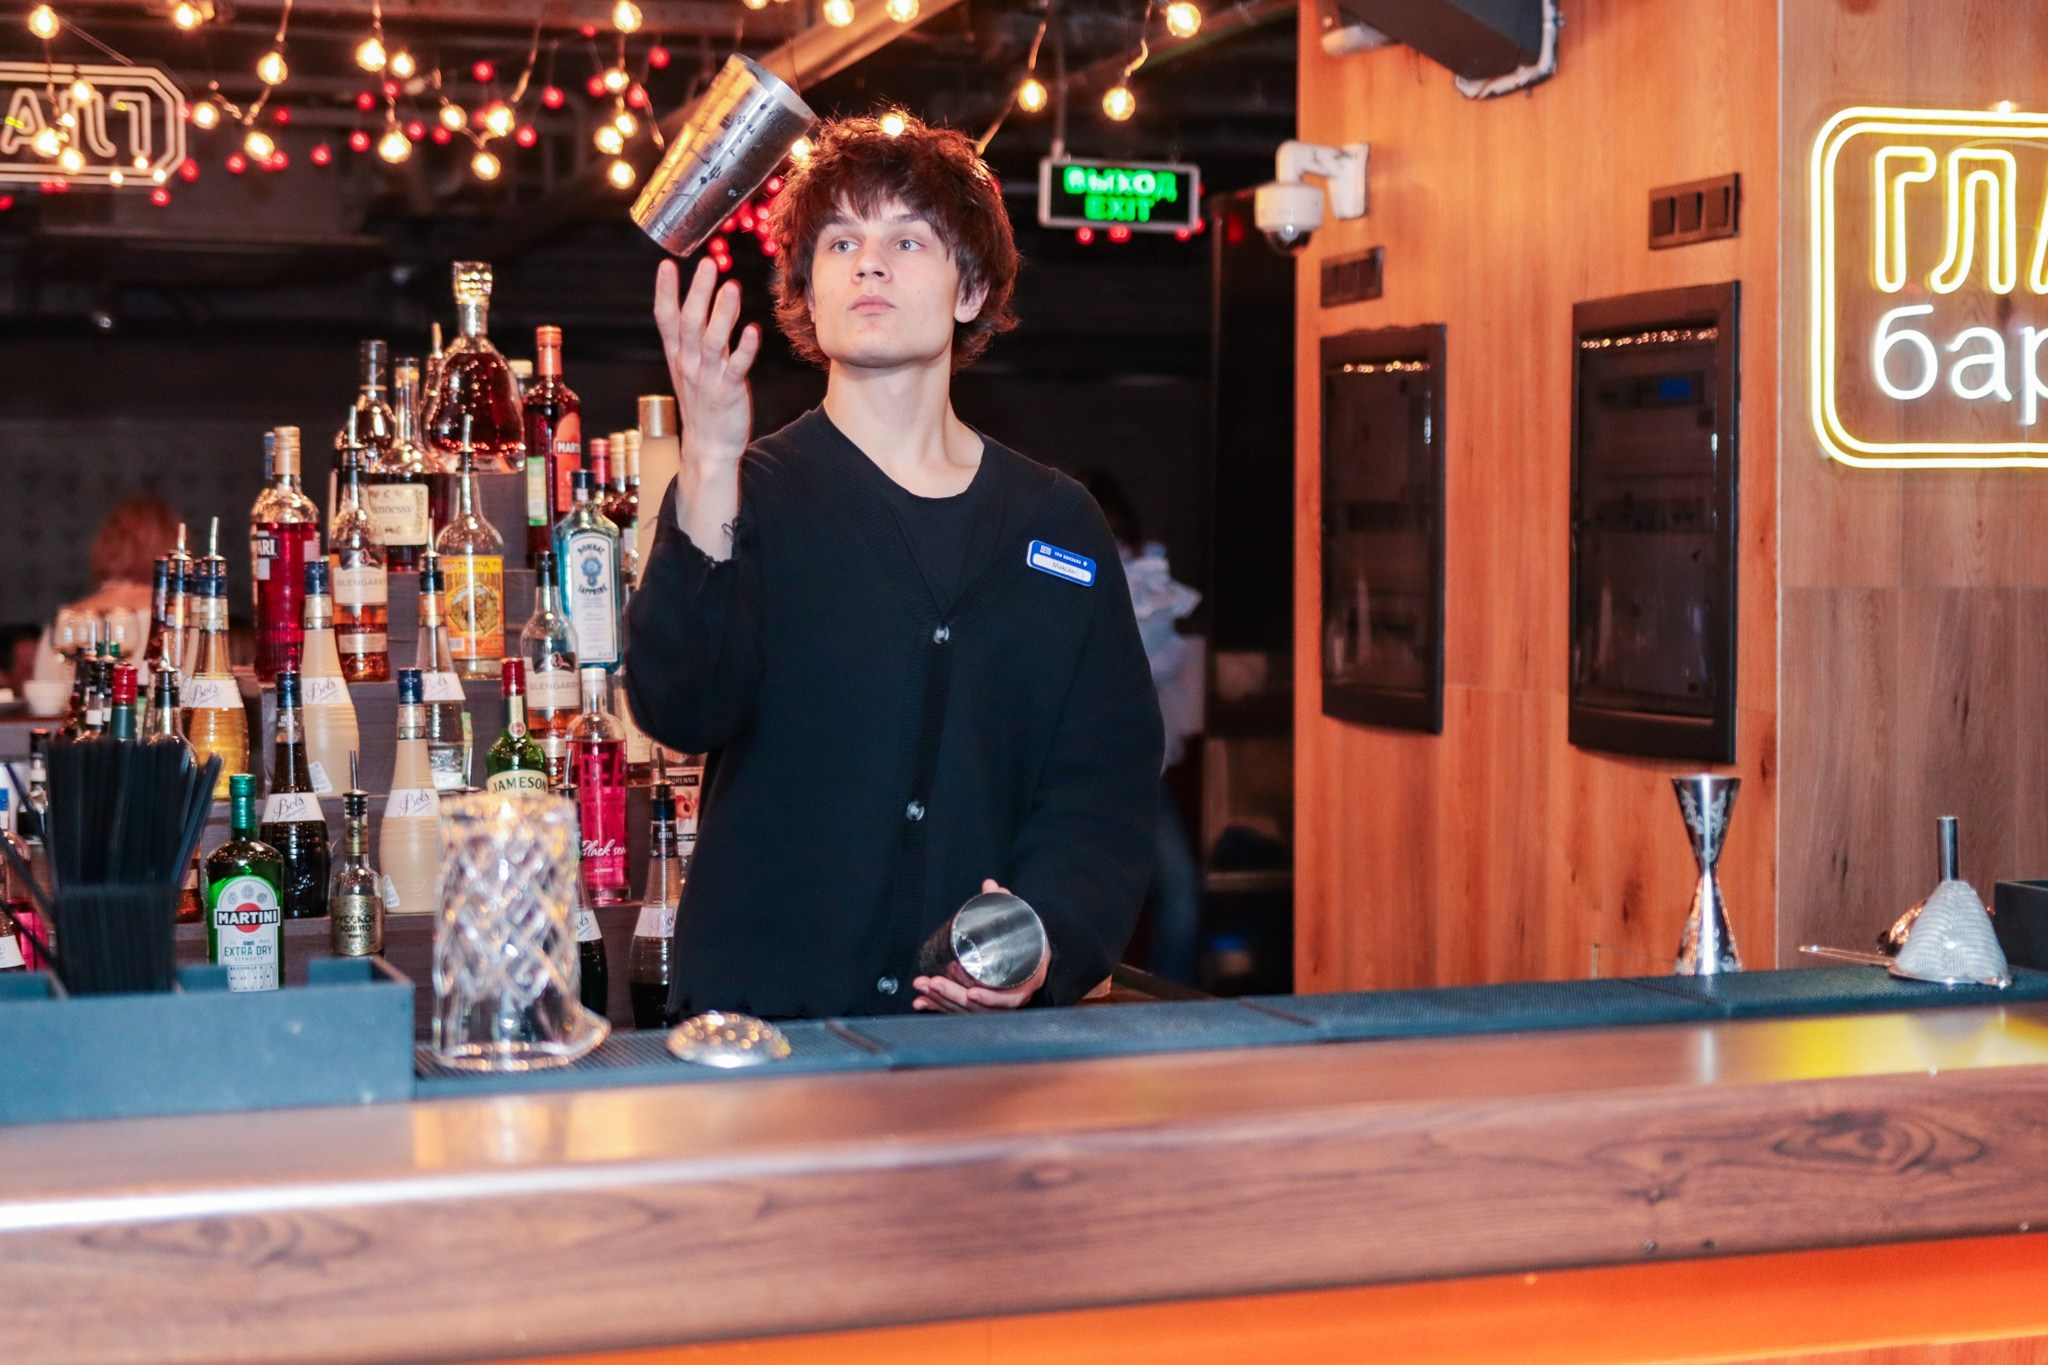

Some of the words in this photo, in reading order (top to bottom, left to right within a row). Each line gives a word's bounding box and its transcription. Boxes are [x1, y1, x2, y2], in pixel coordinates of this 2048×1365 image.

[1085, 194, 1151, 222] EXIT
[1873, 144, 2048, 296] ГЛ
[370, 504, 413, 514] ennessy
[305, 677, 336, 703] Bols
[492, 776, 547, 794] JAMESON
[272, 793, 305, 822] Bols
[399, 787, 430, 816] Bols
[582, 839, 616, 857] Black
[218, 910, 277, 925] MARTINI
[224, 946, 253, 957] EXTRA
[256, 945, 273, 956] DRY
